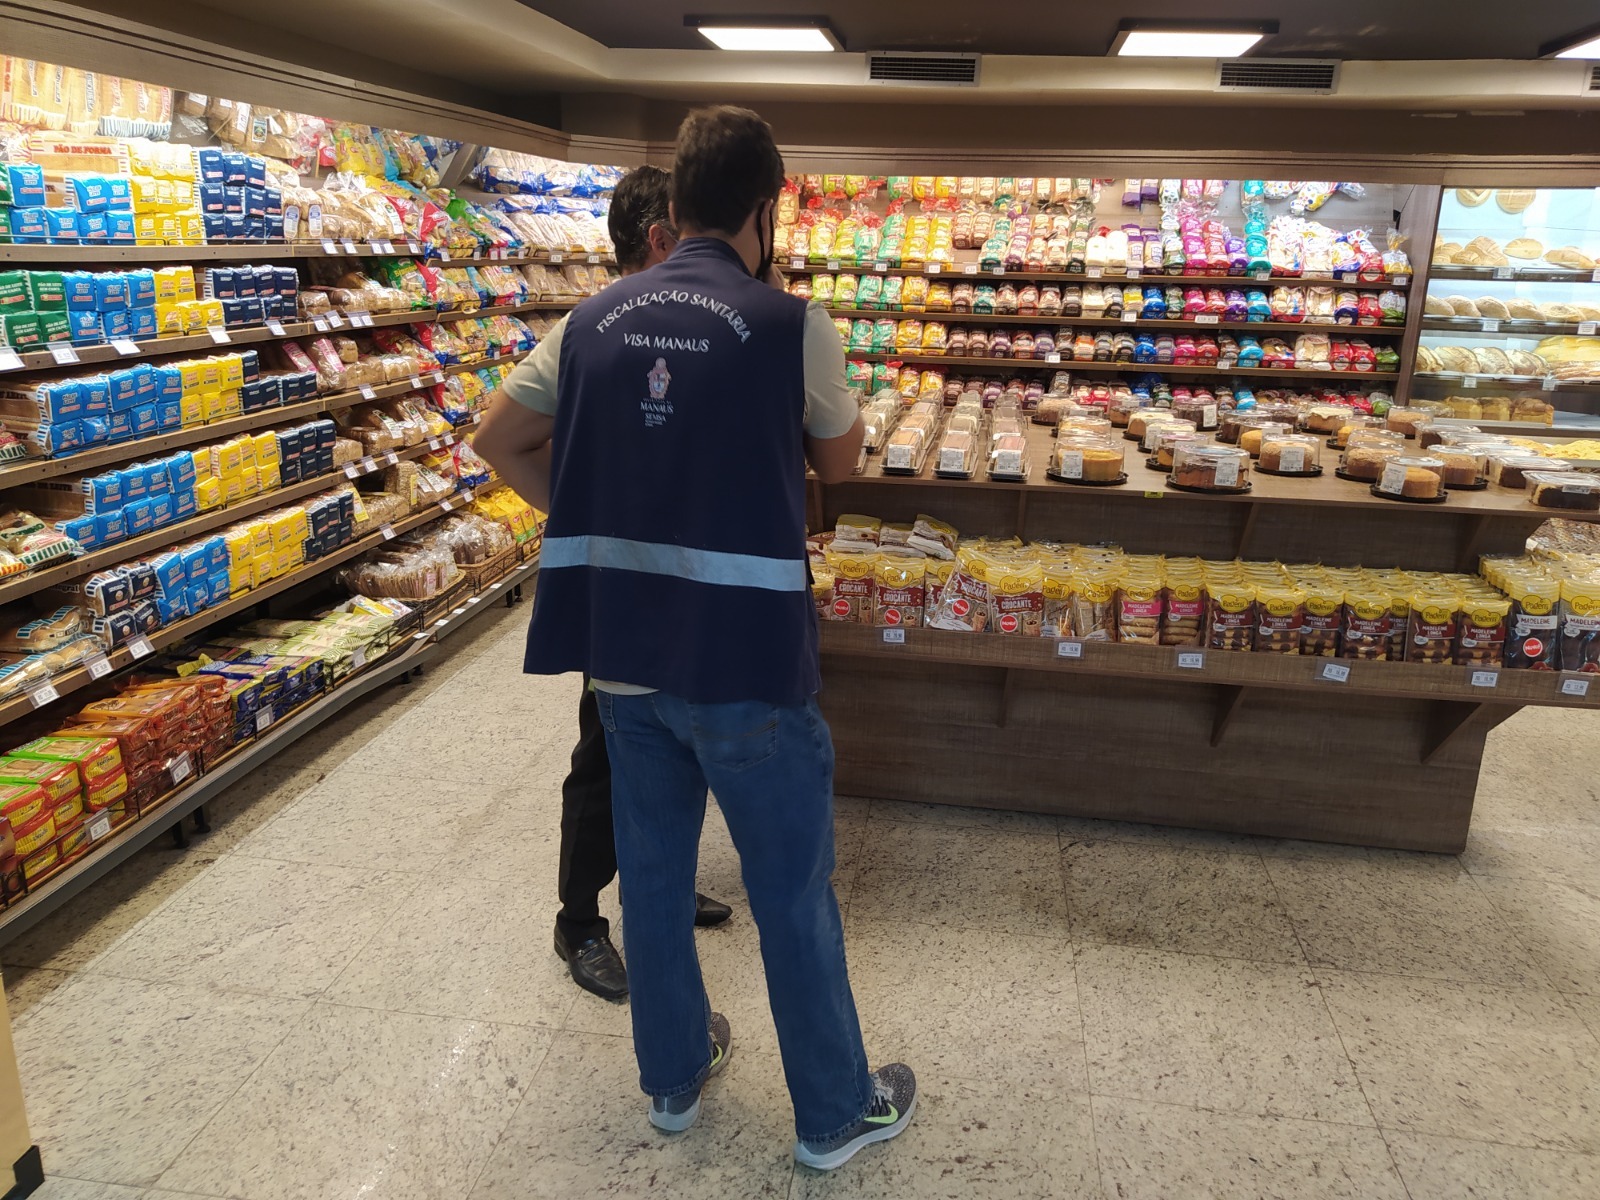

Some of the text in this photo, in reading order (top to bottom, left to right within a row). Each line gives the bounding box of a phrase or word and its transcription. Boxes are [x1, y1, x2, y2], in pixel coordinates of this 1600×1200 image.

[54, 144, 69, 154] PÃO
[84, 146, 112, 154] FORMA
[596, 290, 751, 344] FISCALIZAÇÃO SANITÁRIA
[623, 333, 711, 353] VISA MANAUS
[640, 401, 674, 415] MANAUS
[839, 584, 868, 594] CROCANTE
[884, 593, 911, 603] CROCANTE
[1001, 599, 1032, 609] CROCANTE
